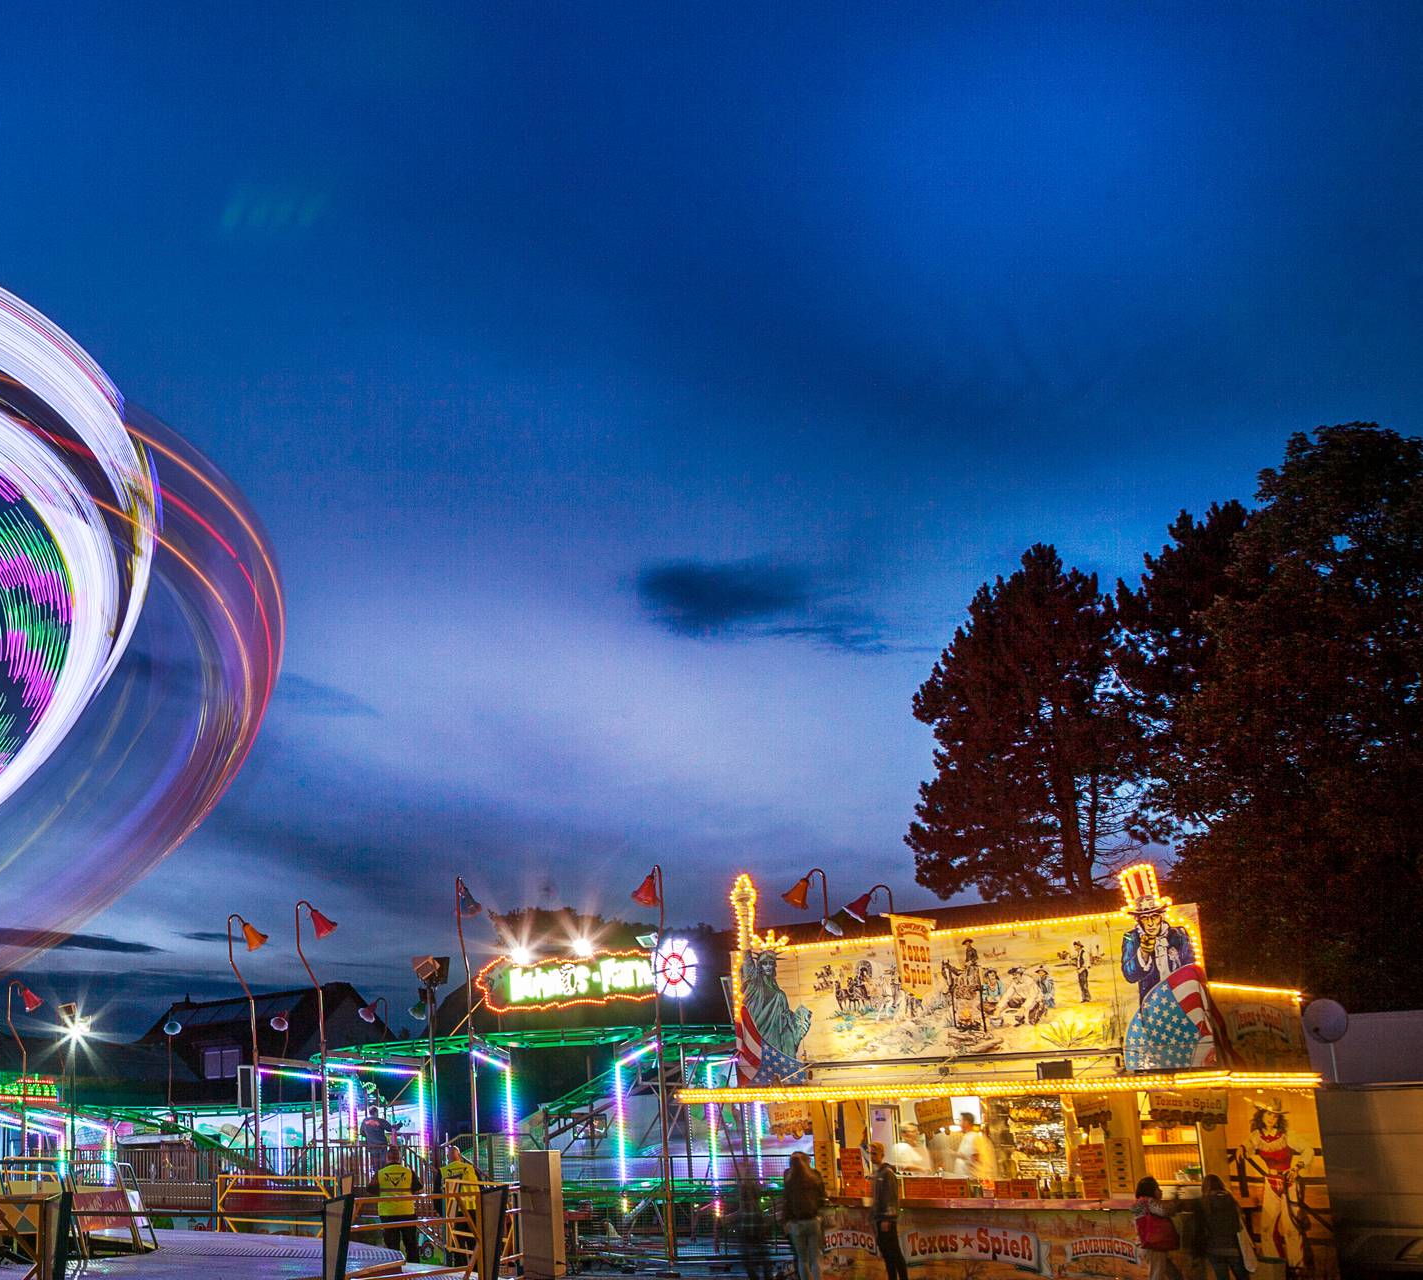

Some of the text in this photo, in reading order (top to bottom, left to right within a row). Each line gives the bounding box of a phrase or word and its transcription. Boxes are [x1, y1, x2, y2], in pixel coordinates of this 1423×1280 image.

[824, 1232, 875, 1250] HOT DOG
[907, 1226, 1033, 1261] Texas Spieß
[1071, 1238, 1135, 1258] HAMBURGER
